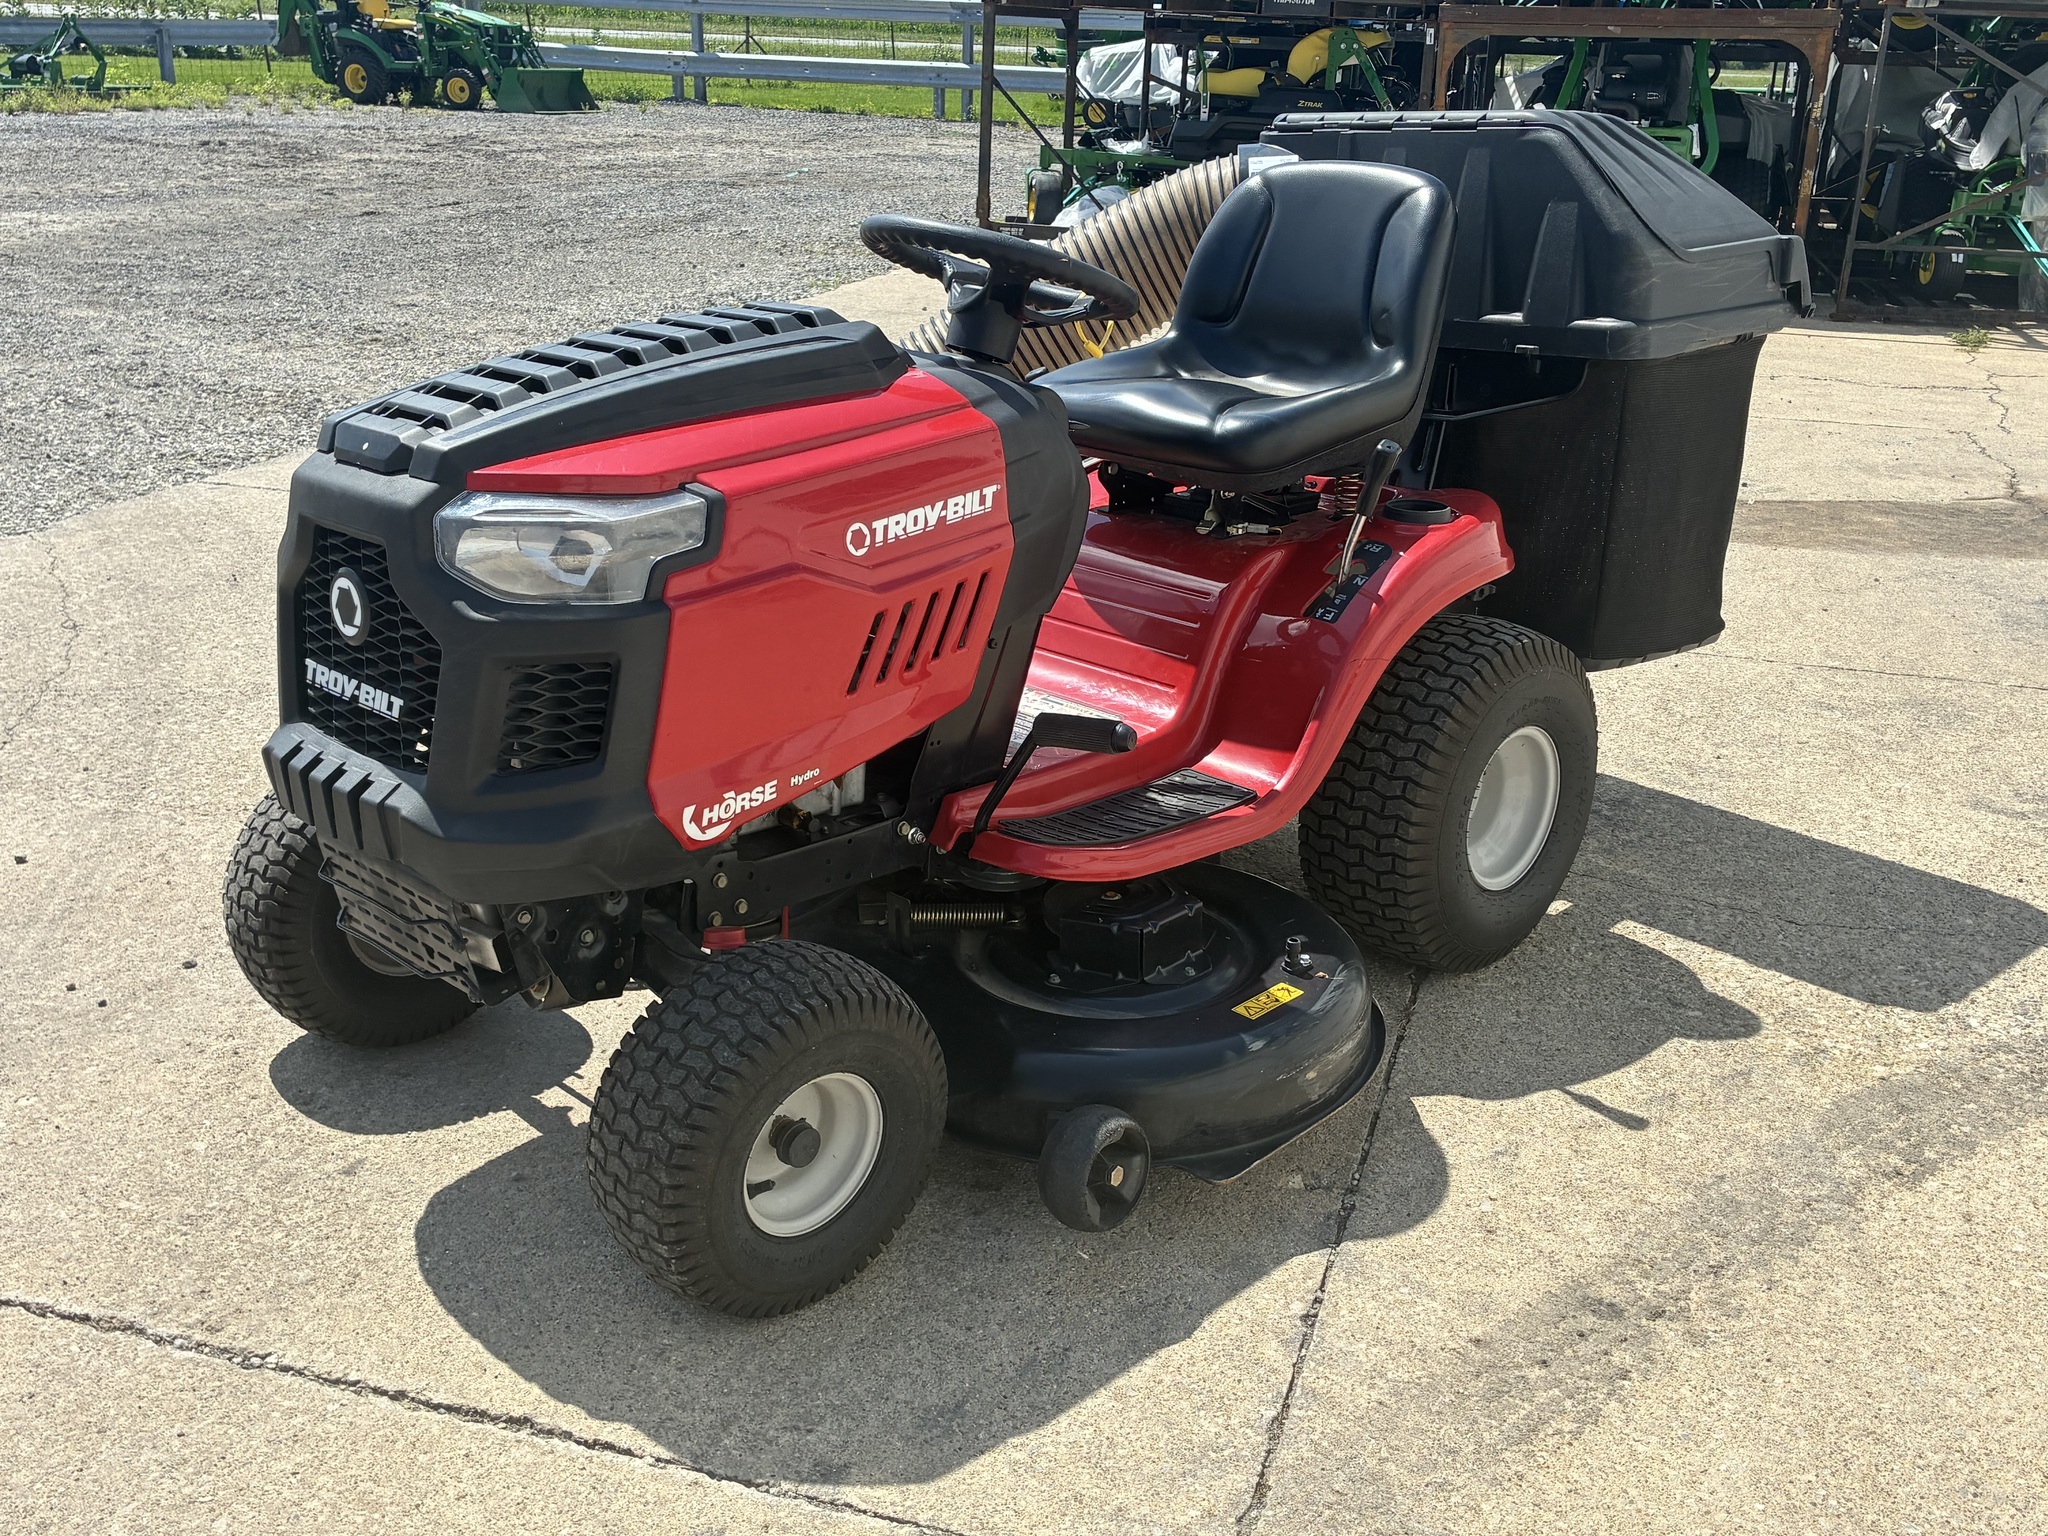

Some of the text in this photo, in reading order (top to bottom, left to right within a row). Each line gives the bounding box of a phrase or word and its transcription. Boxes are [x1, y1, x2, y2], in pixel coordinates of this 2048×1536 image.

[1297, 100, 1323, 108] ZTRAK
[871, 484, 1000, 544] TROY-BILT
[305, 658, 404, 720] TROY-BILT
[790, 767, 820, 787] Hydro
[701, 779, 778, 828] HORSE
